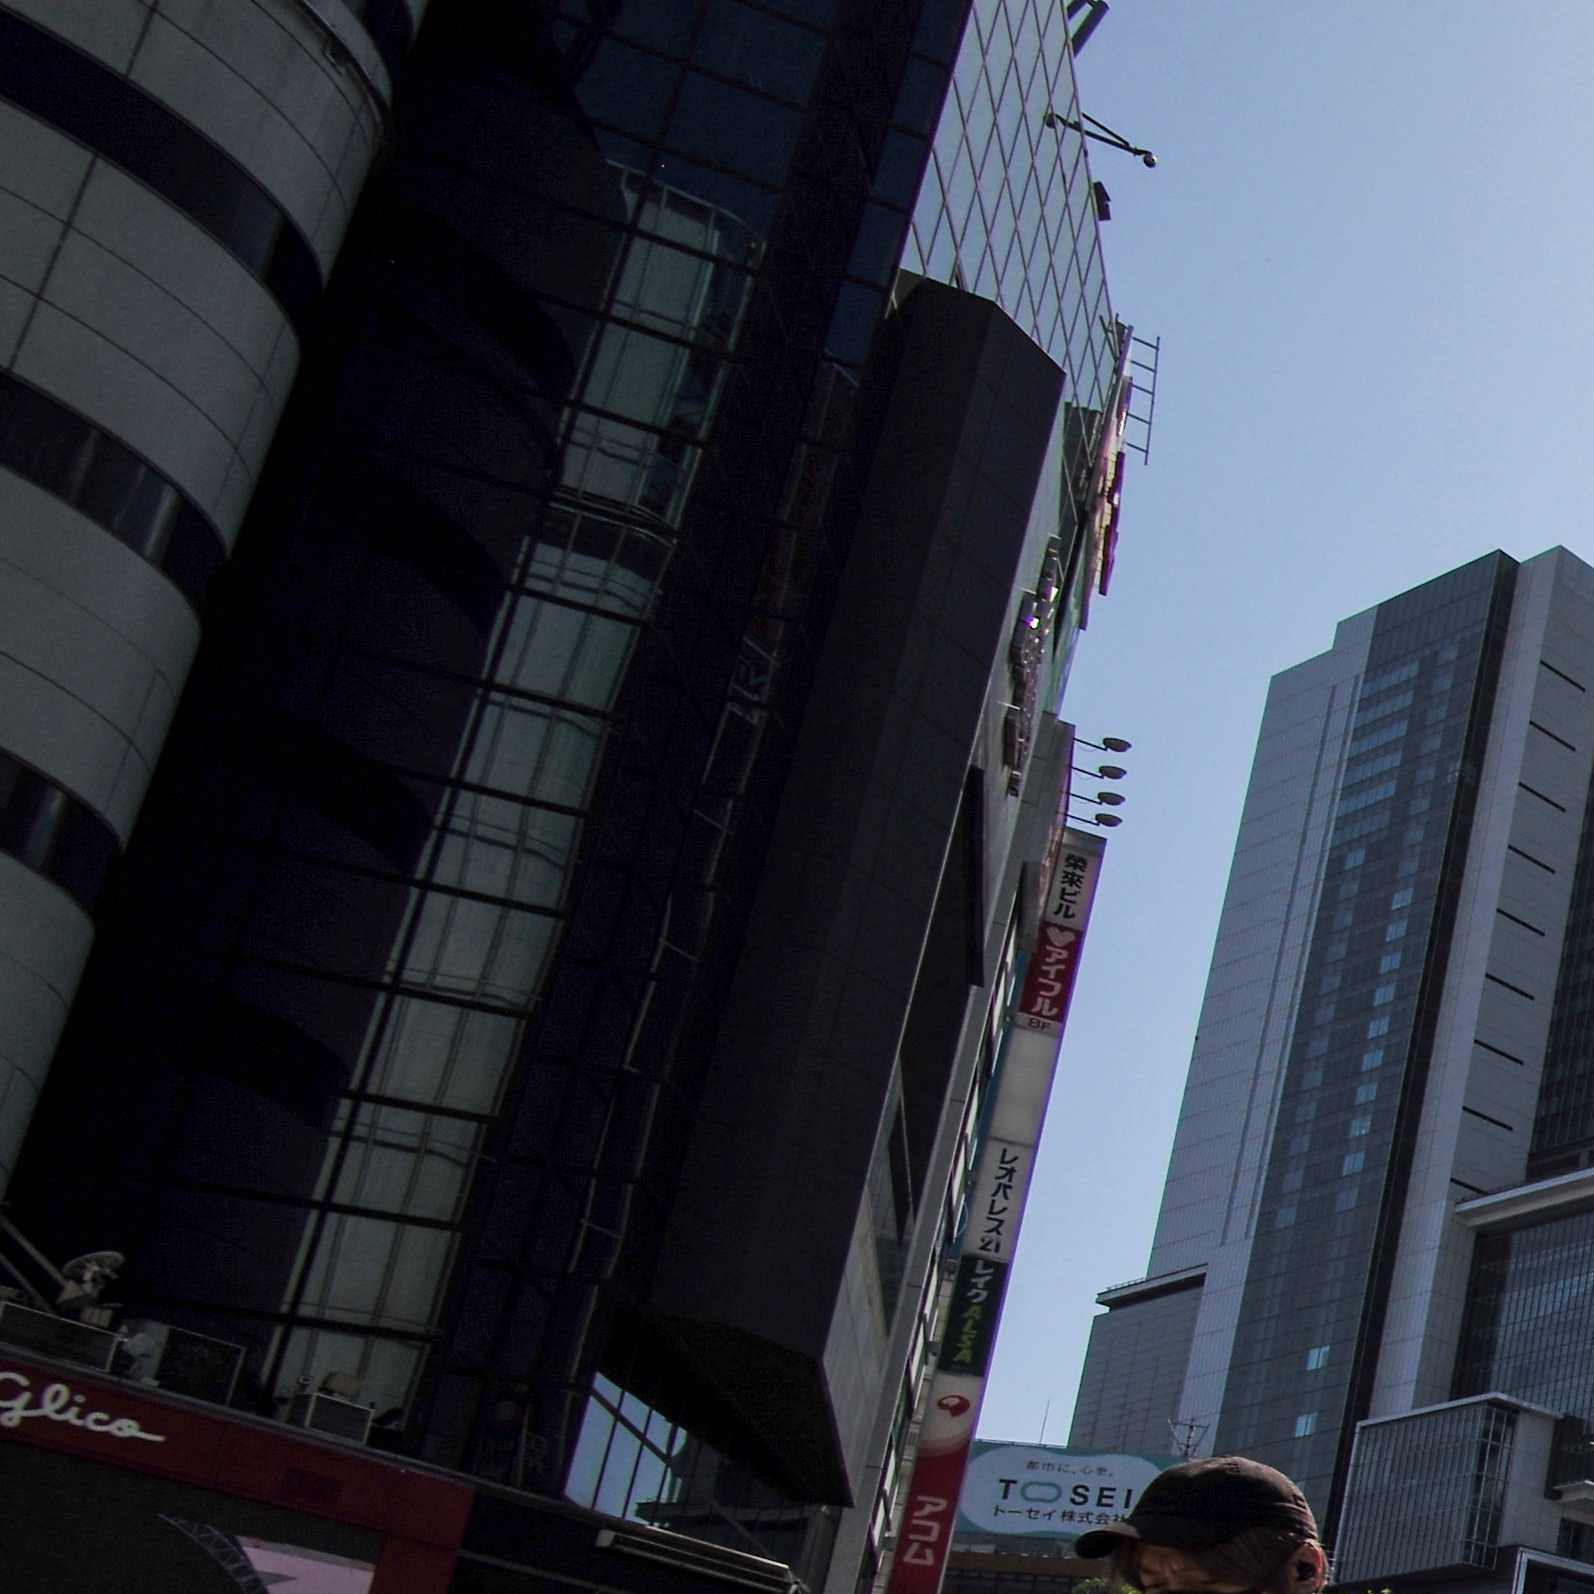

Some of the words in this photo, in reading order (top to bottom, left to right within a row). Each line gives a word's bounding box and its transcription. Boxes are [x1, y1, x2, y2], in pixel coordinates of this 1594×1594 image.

[1030, 949, 1070, 1017] アイフル
[0, 1371, 166, 1442] Glico
[903, 1496, 948, 1566] アコム
